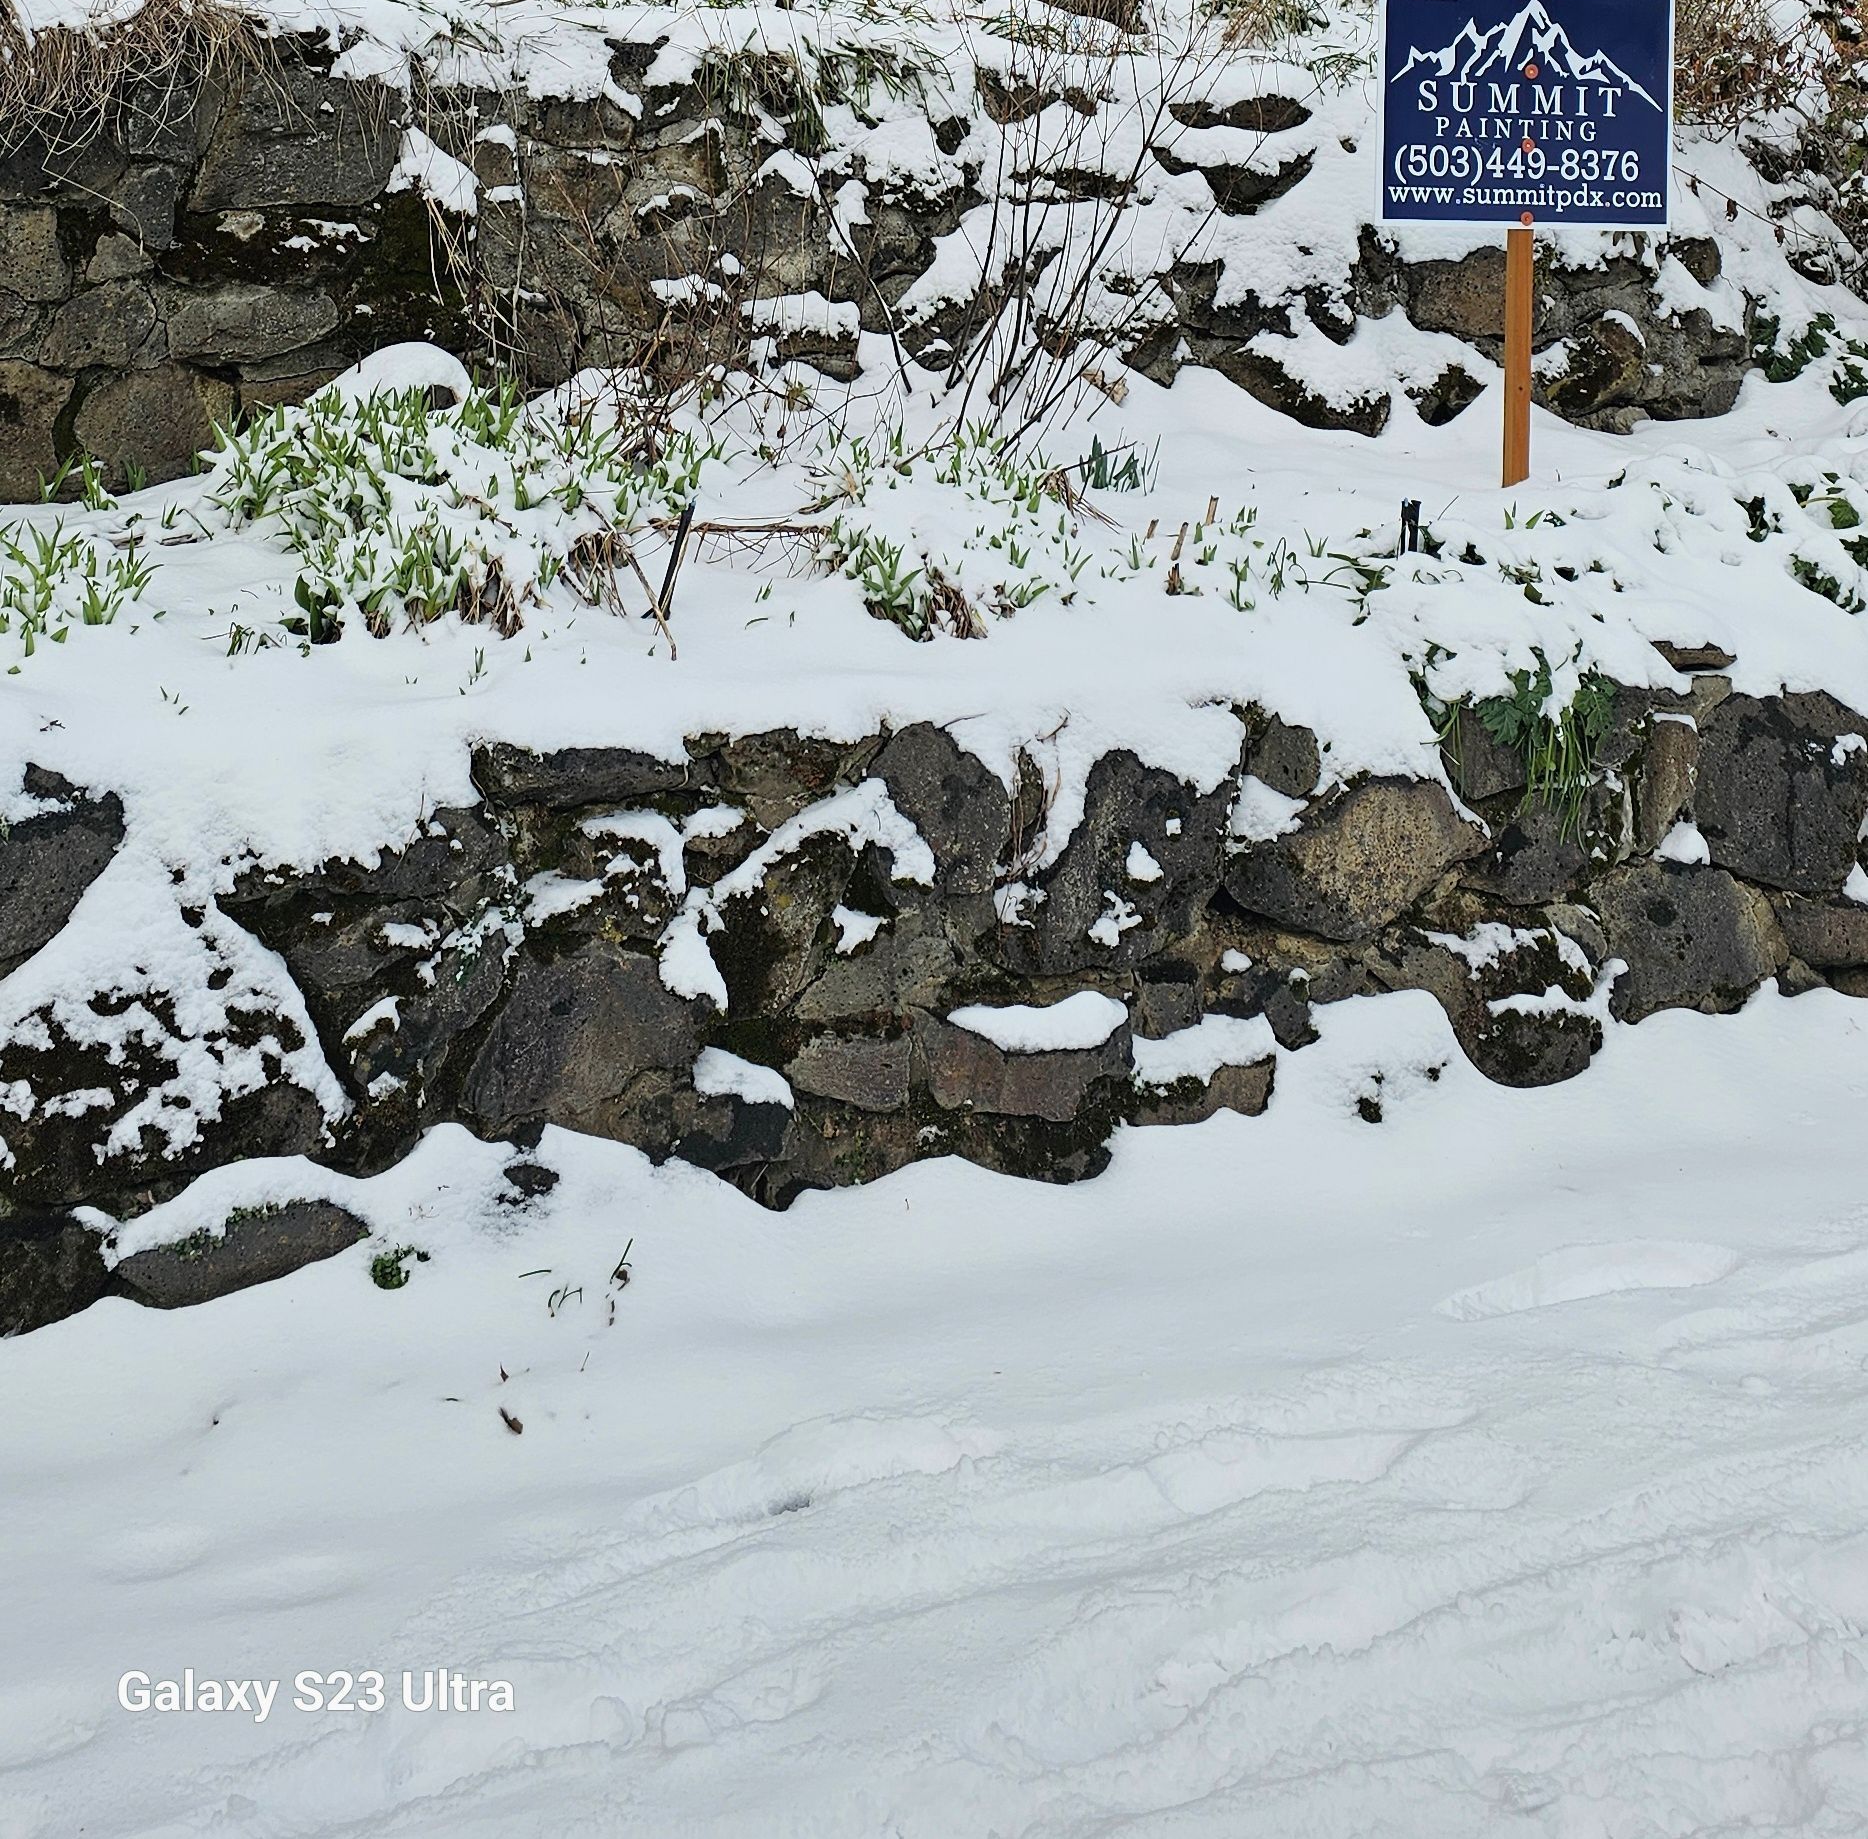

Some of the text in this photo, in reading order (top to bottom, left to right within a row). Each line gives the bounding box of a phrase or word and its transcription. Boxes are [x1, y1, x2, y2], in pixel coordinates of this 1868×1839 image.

[1418, 80, 1622, 117] SUMMIT
[1435, 116, 1597, 142] PAINTING
[1394, 143, 1640, 186] (503)449-8376
[1388, 182, 1663, 213] www.summitpdx.com
